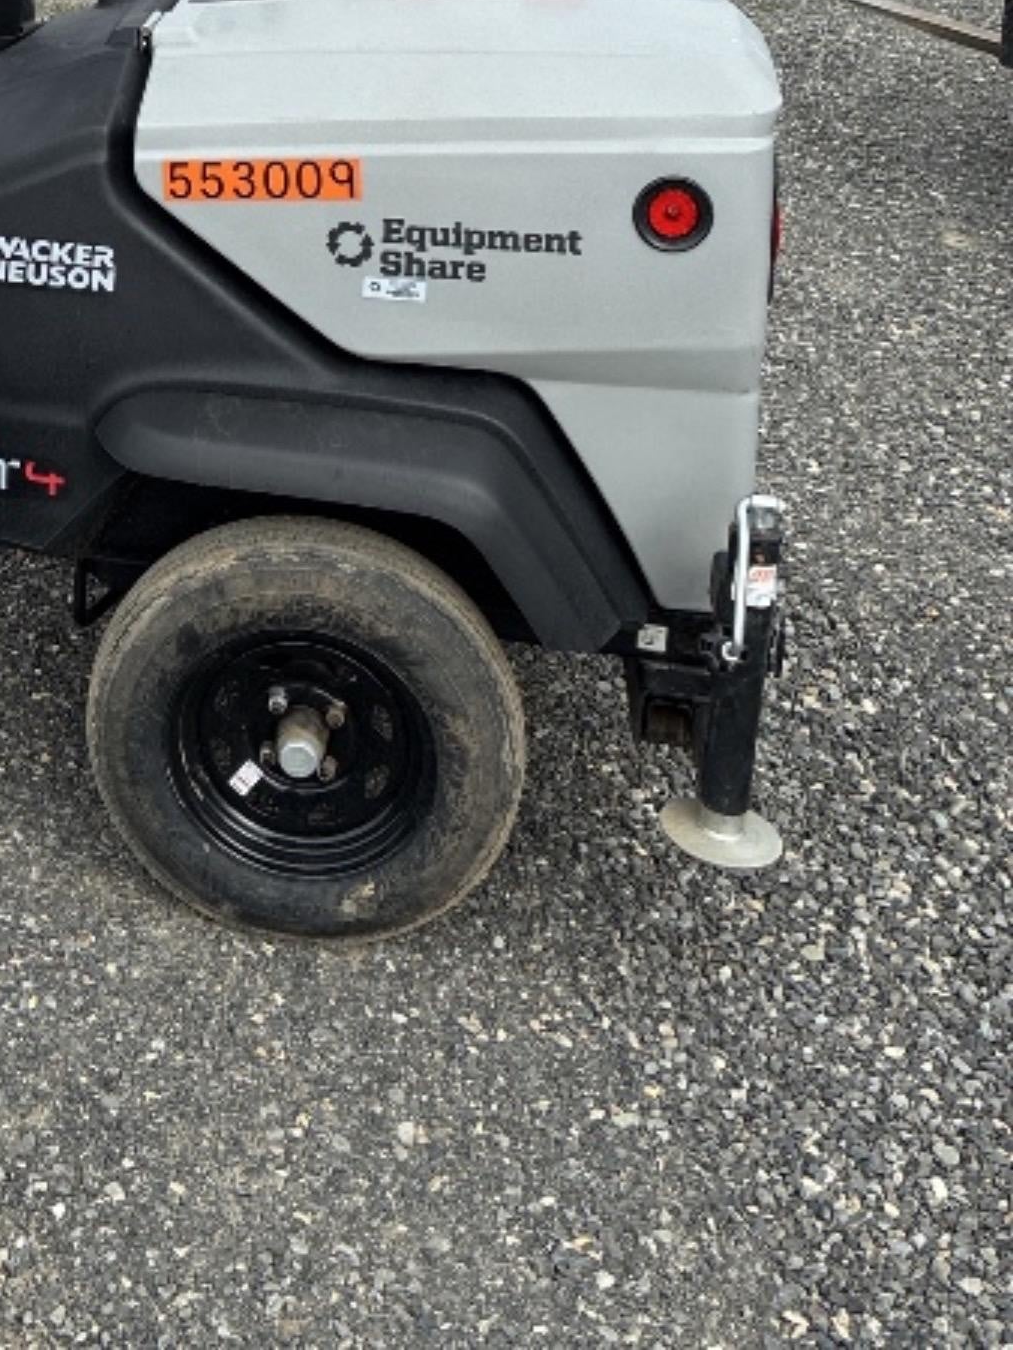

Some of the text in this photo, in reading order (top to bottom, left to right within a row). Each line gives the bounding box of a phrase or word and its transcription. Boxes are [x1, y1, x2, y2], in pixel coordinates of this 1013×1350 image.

[168, 160, 356, 199] 553009
[382, 218, 583, 255] Equipment
[380, 250, 487, 282] Share
